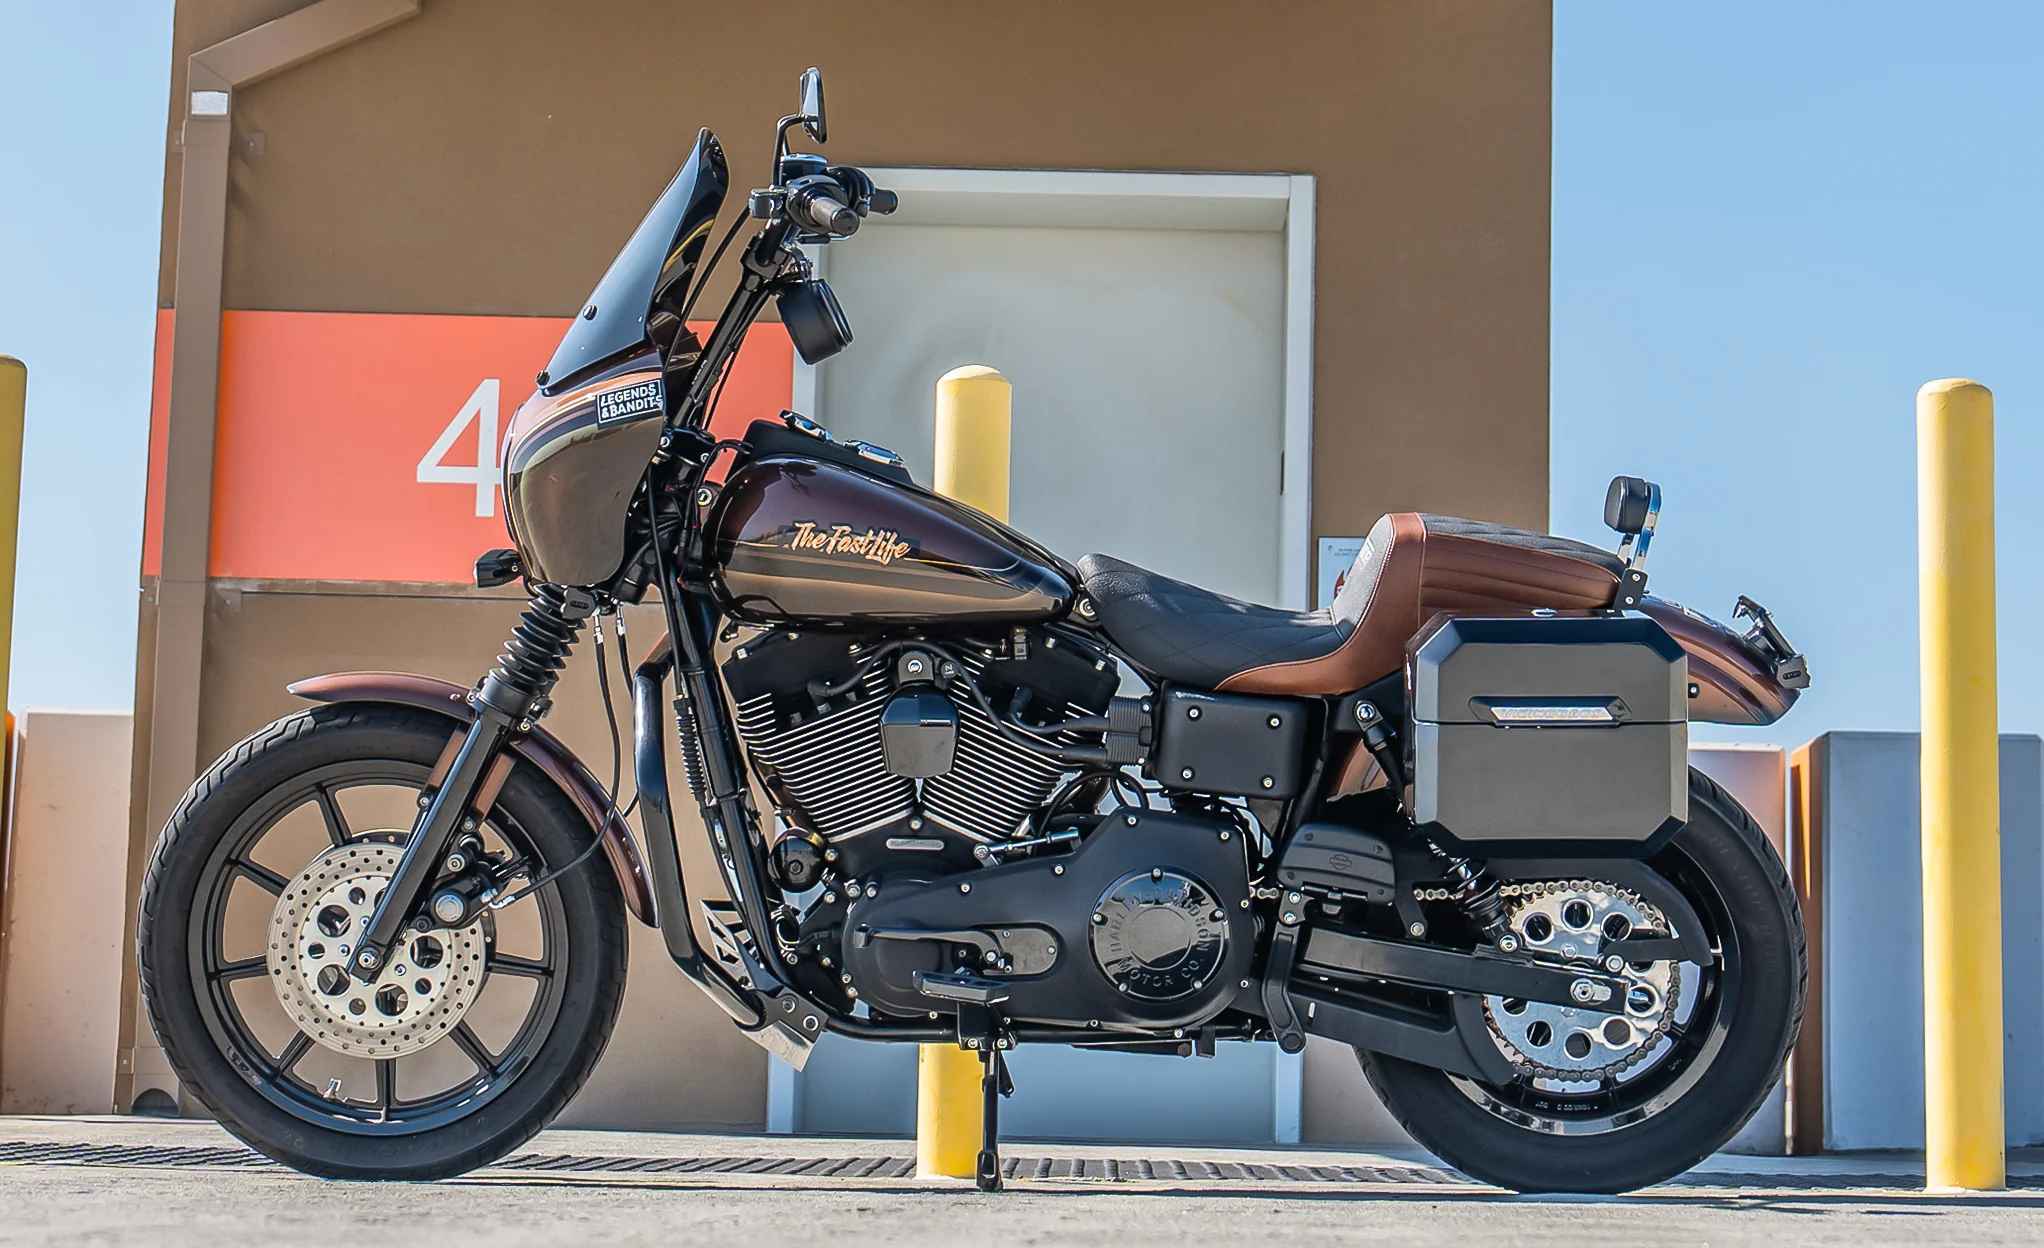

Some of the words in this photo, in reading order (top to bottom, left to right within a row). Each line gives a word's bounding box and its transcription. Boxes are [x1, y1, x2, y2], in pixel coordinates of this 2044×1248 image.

[601, 383, 657, 407] LEGENDS
[416, 378, 501, 517] 4
[1118, 957, 1174, 987] MOTOR
